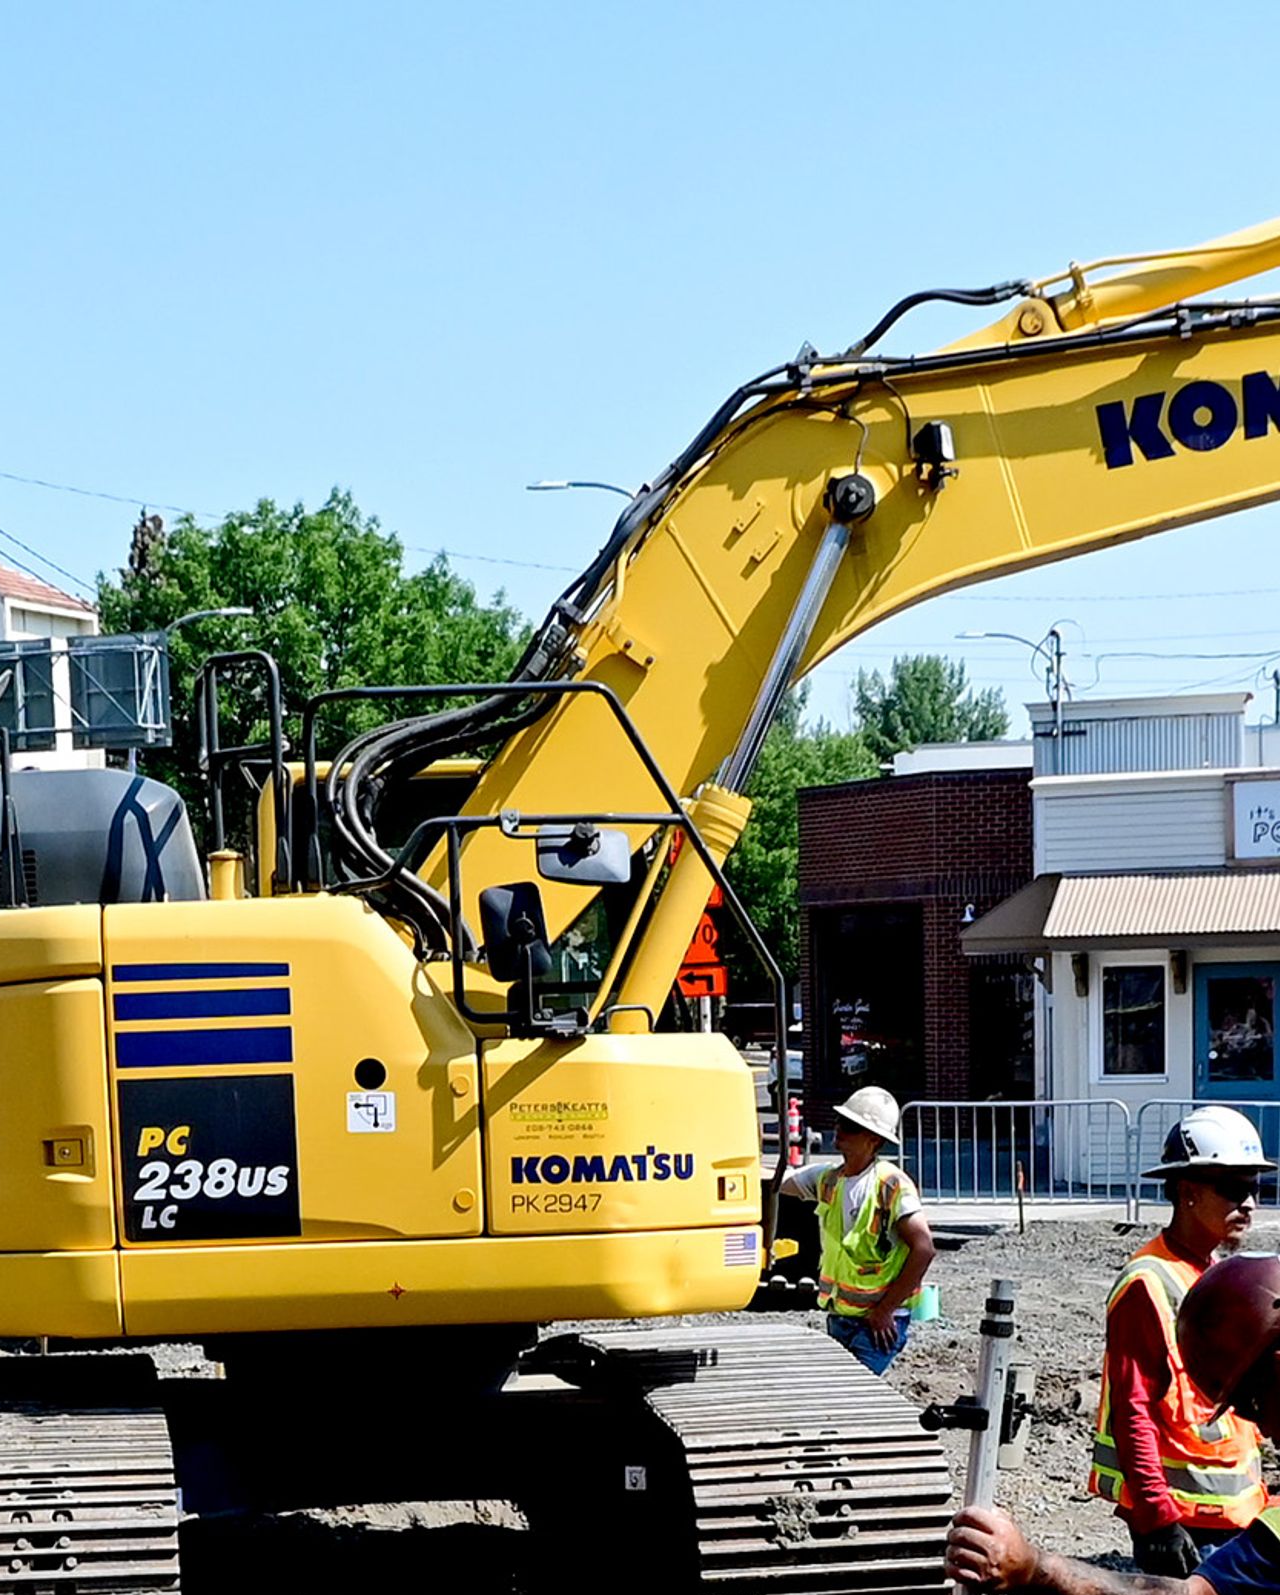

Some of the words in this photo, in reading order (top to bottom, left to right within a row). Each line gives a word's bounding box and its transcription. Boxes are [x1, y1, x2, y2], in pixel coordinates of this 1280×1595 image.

[137, 1125, 191, 1157] PC
[511, 1145, 693, 1185] KOMATSU
[141, 1204, 179, 1229] LC
[544, 1194, 602, 1213] 2947
